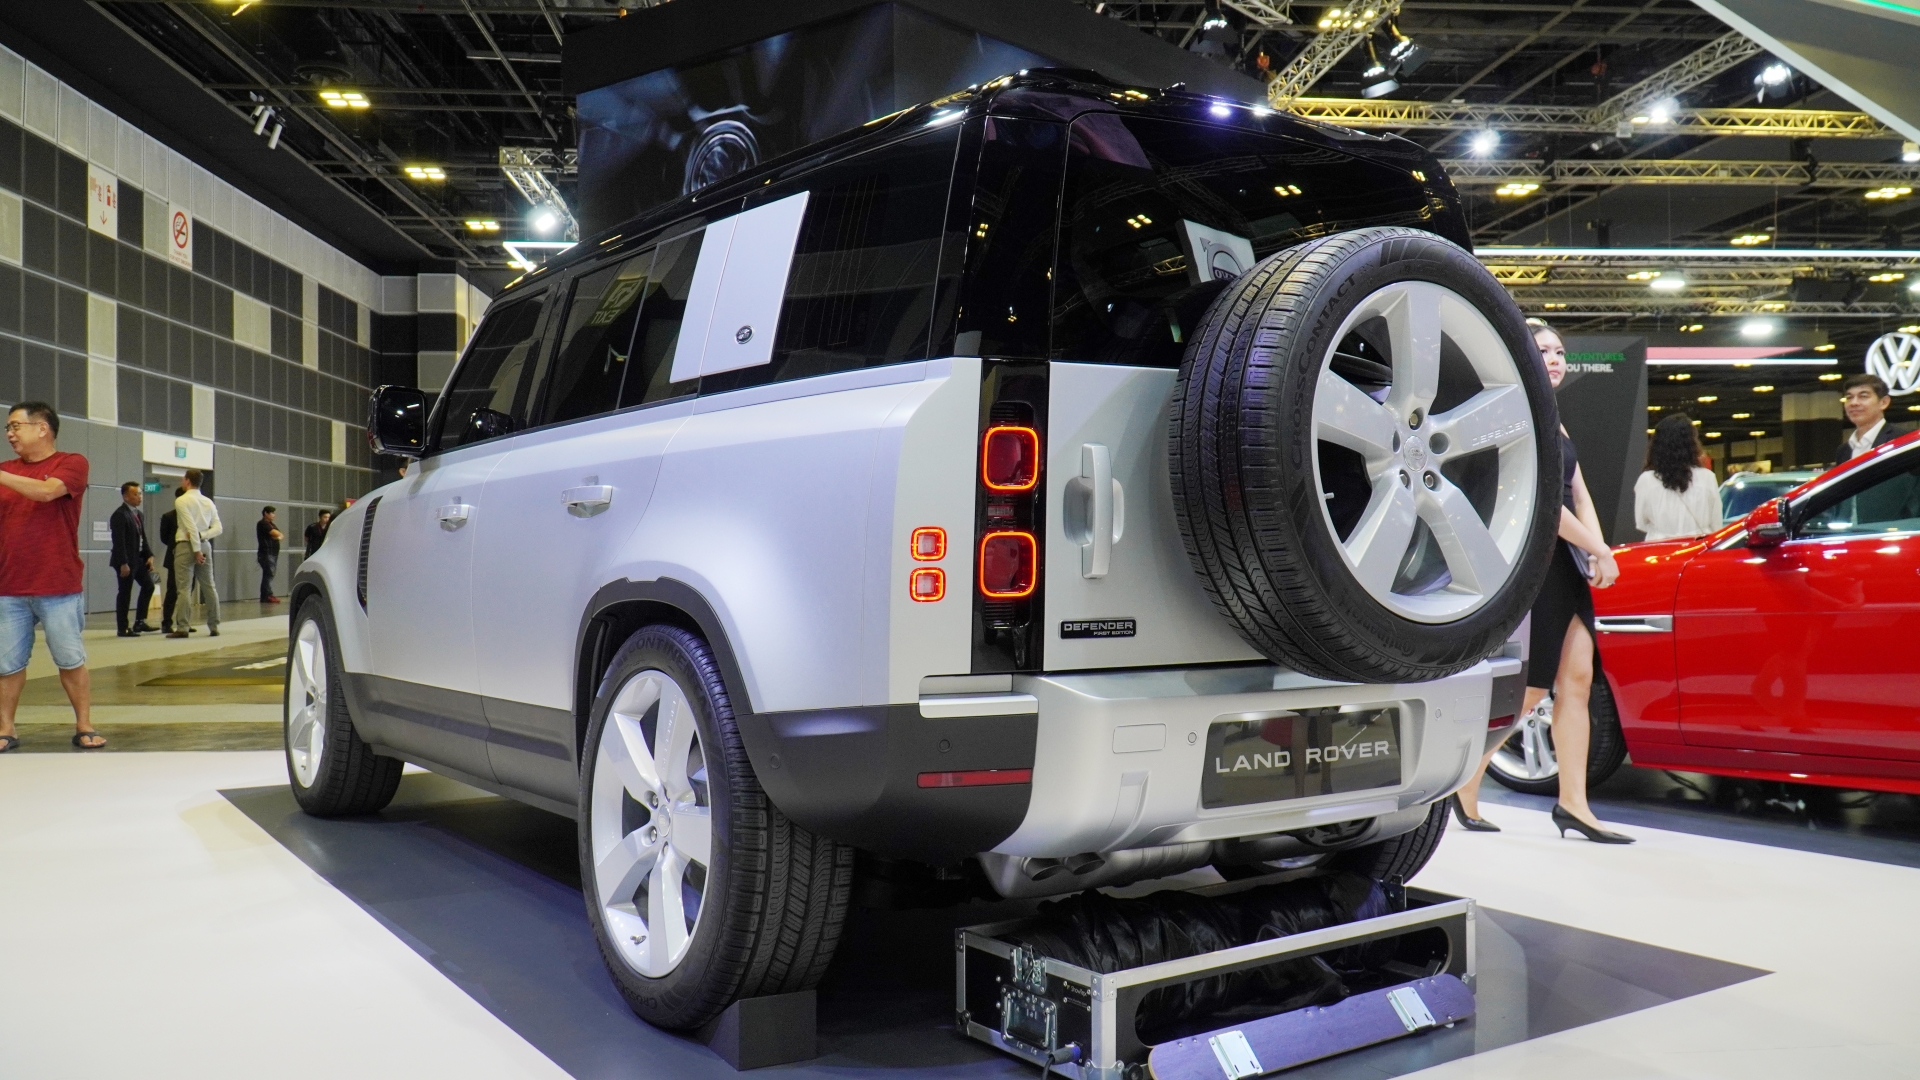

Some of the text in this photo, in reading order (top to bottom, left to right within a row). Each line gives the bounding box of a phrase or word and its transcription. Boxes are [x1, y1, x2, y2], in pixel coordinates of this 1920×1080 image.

[1565, 363, 1614, 373] OU THERE.
[144, 484, 157, 492] EXIT
[1063, 621, 1134, 631] DEFENDER
[1215, 740, 1390, 774] LAND ROVER
